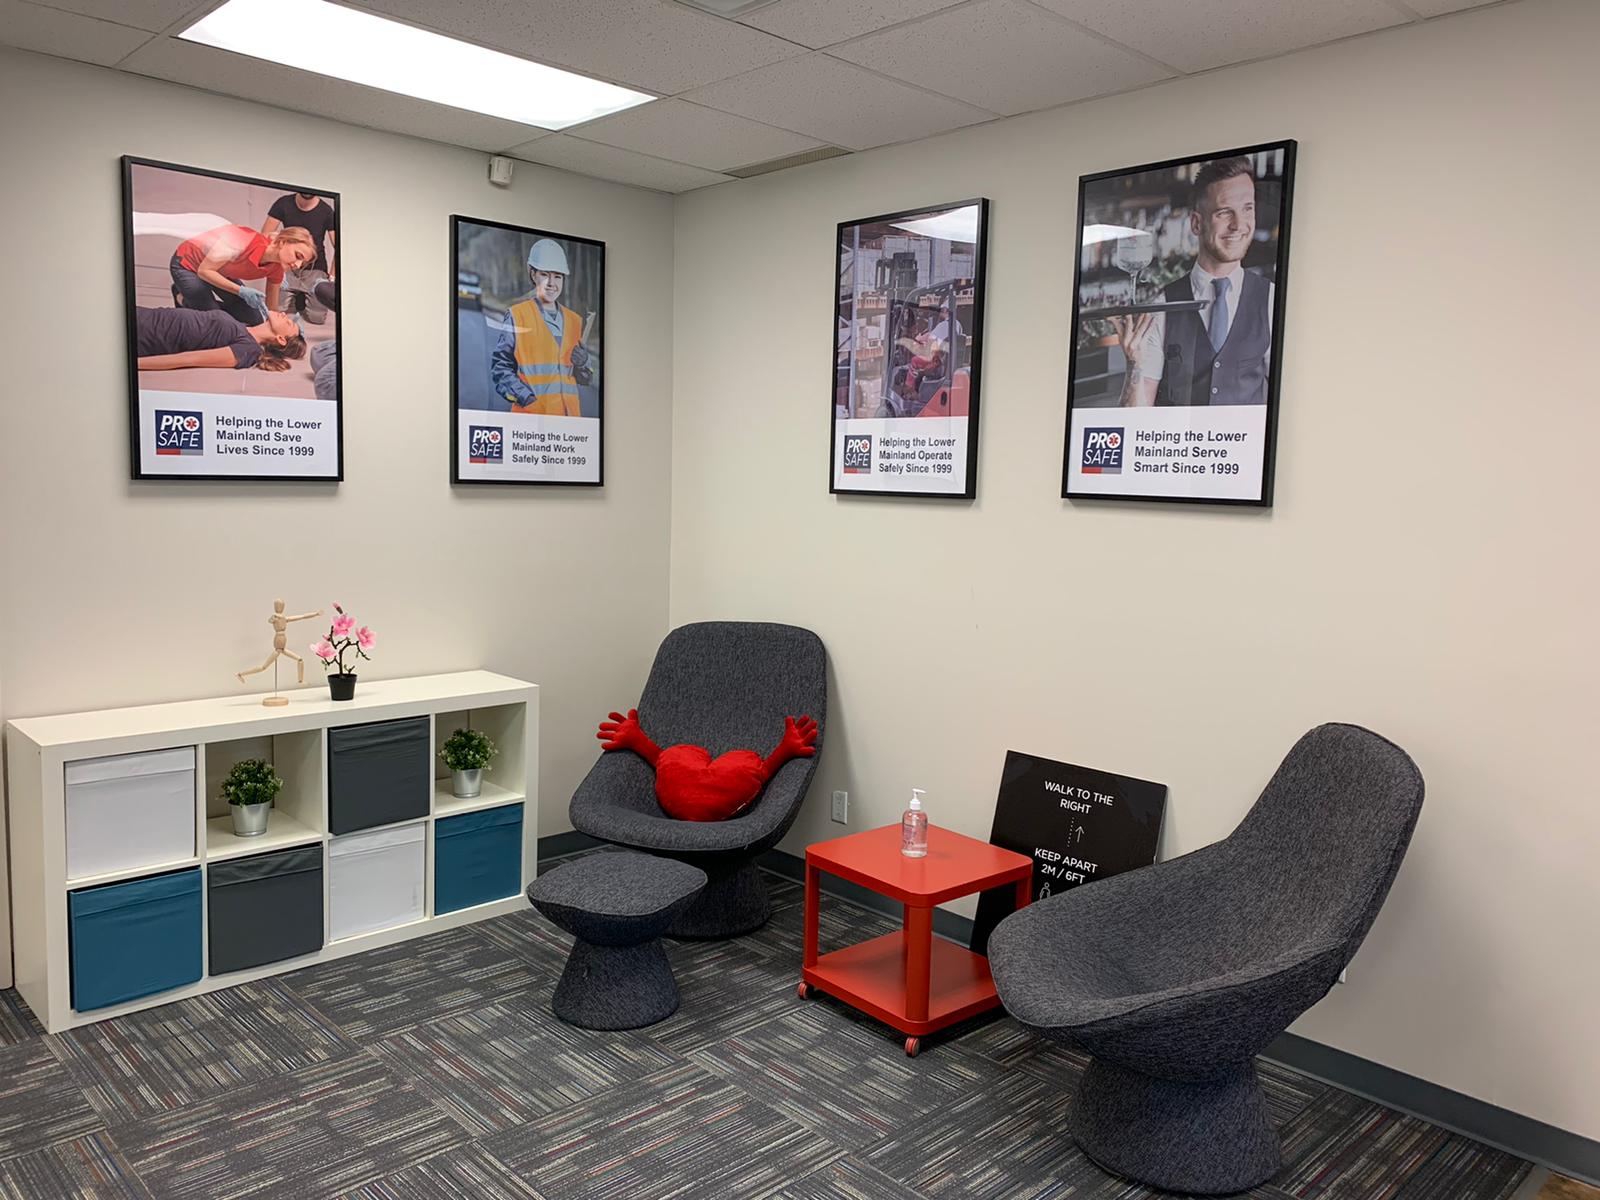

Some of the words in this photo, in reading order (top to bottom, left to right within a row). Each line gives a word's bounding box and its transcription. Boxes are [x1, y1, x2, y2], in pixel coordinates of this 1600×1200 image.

[216, 416, 262, 429] Helping
[266, 418, 284, 428] the
[288, 419, 322, 430] Lower
[158, 431, 200, 447] SAFE
[216, 430, 270, 441] Mainland
[274, 432, 302, 442] Save
[512, 430, 546, 442] Helping
[548, 432, 560, 441] the
[563, 433, 588, 442] Lower
[1136, 431, 1181, 444] Helping
[1185, 431, 1203, 441] the
[1208, 431, 1247, 442] Lower
[512, 443, 551, 452] Mainland
[553, 444, 575, 453] Work
[880, 438, 910, 448] Helping
[912, 438, 926, 446] the
[928, 438, 956, 446] Lower
[216, 444, 248, 454] Lives
[252, 445, 285, 455] Since
[288, 446, 314, 456] 1999
[471, 444, 501, 456] SAFE
[879, 451, 916, 460] Mainland
[918, 451, 952, 461] Operate
[1135, 446, 1188, 457] Mainland
[1192, 447, 1227, 458] Serve
[512, 454, 539, 465] Safely
[541, 455, 564, 464] Since
[568, 456, 586, 465] 1999
[844, 453, 870, 466] SAFE
[1084, 449, 1120, 465] SAFE
[879, 463, 903, 474] Safely
[906, 464, 929, 473] Since
[932, 464, 952, 473] 1999
[1134, 462, 1168, 473] Smart
[1172, 462, 1205, 474] Since
[1210, 463, 1239, 474] 1999
[1044, 780, 1074, 796] WALK
[1077, 788, 1090, 800] TO
[1093, 792, 1114, 806] THE
[1060, 798, 1092, 814] RIGHT
[1034, 848, 1061, 862] KEEP
[1062, 856, 1098, 873] APART
[1041, 864, 1056, 876] 2M
[1056, 868, 1064, 878] /
[1066, 871, 1085, 884] 6FT
